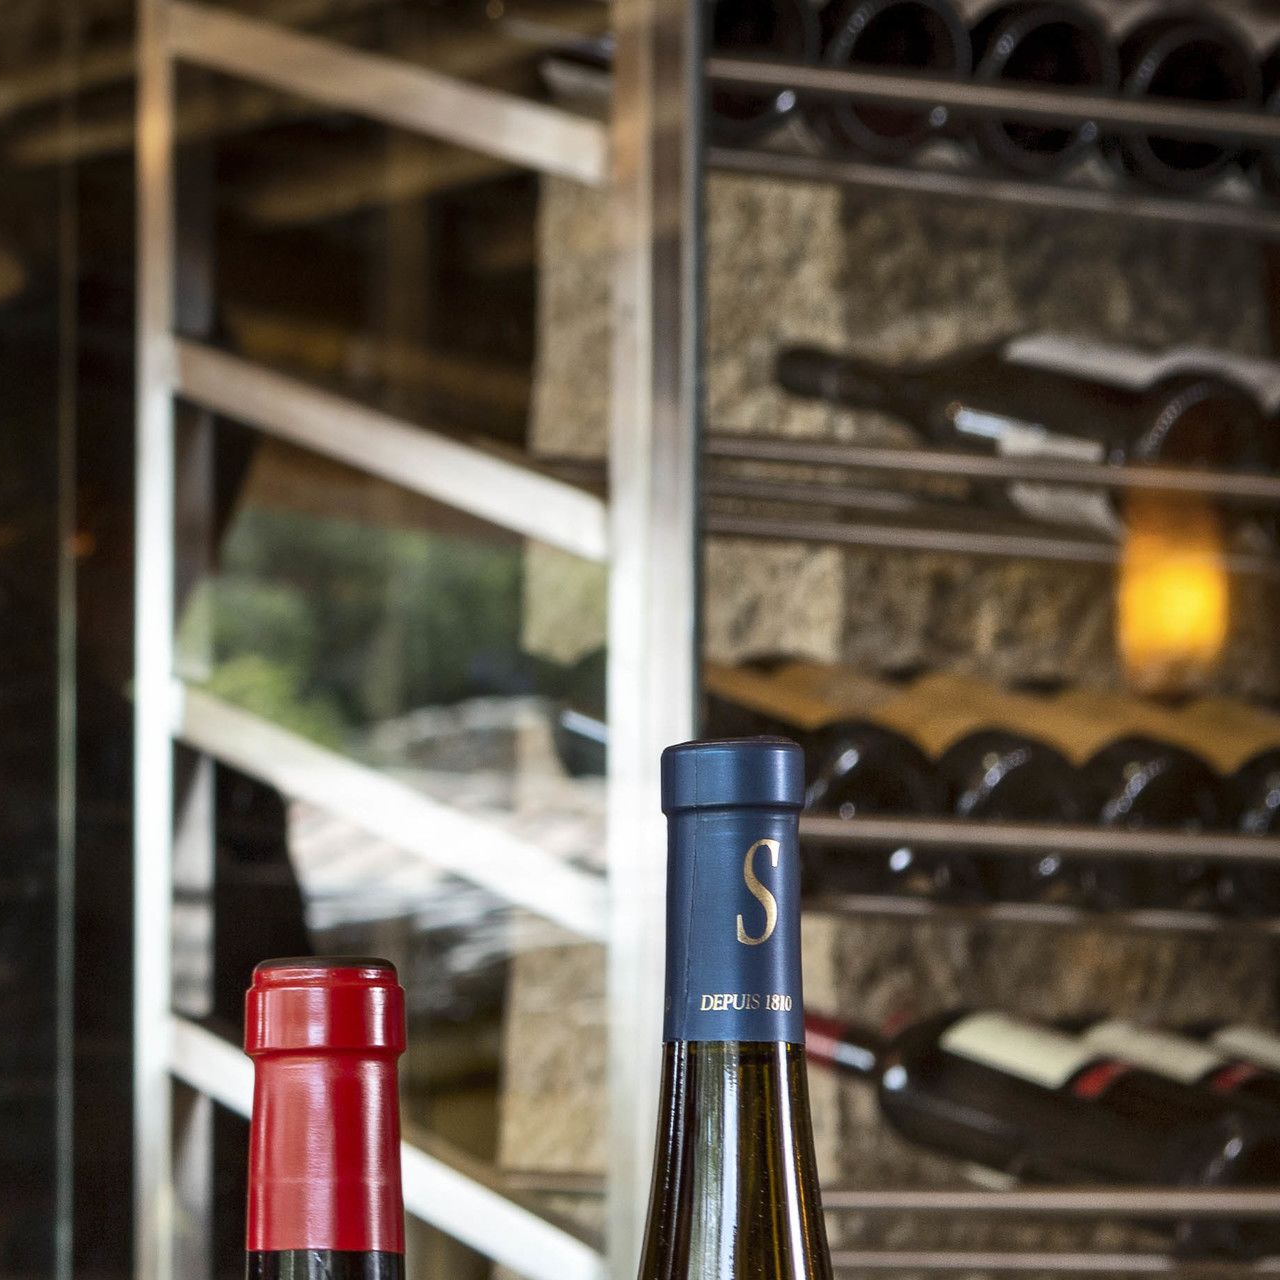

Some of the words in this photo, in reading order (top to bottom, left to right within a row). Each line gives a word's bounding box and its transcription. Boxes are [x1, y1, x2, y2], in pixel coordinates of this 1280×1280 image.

[736, 838, 781, 946] S
[699, 993, 761, 1012] DEPUIS
[765, 993, 793, 1012] 1810
